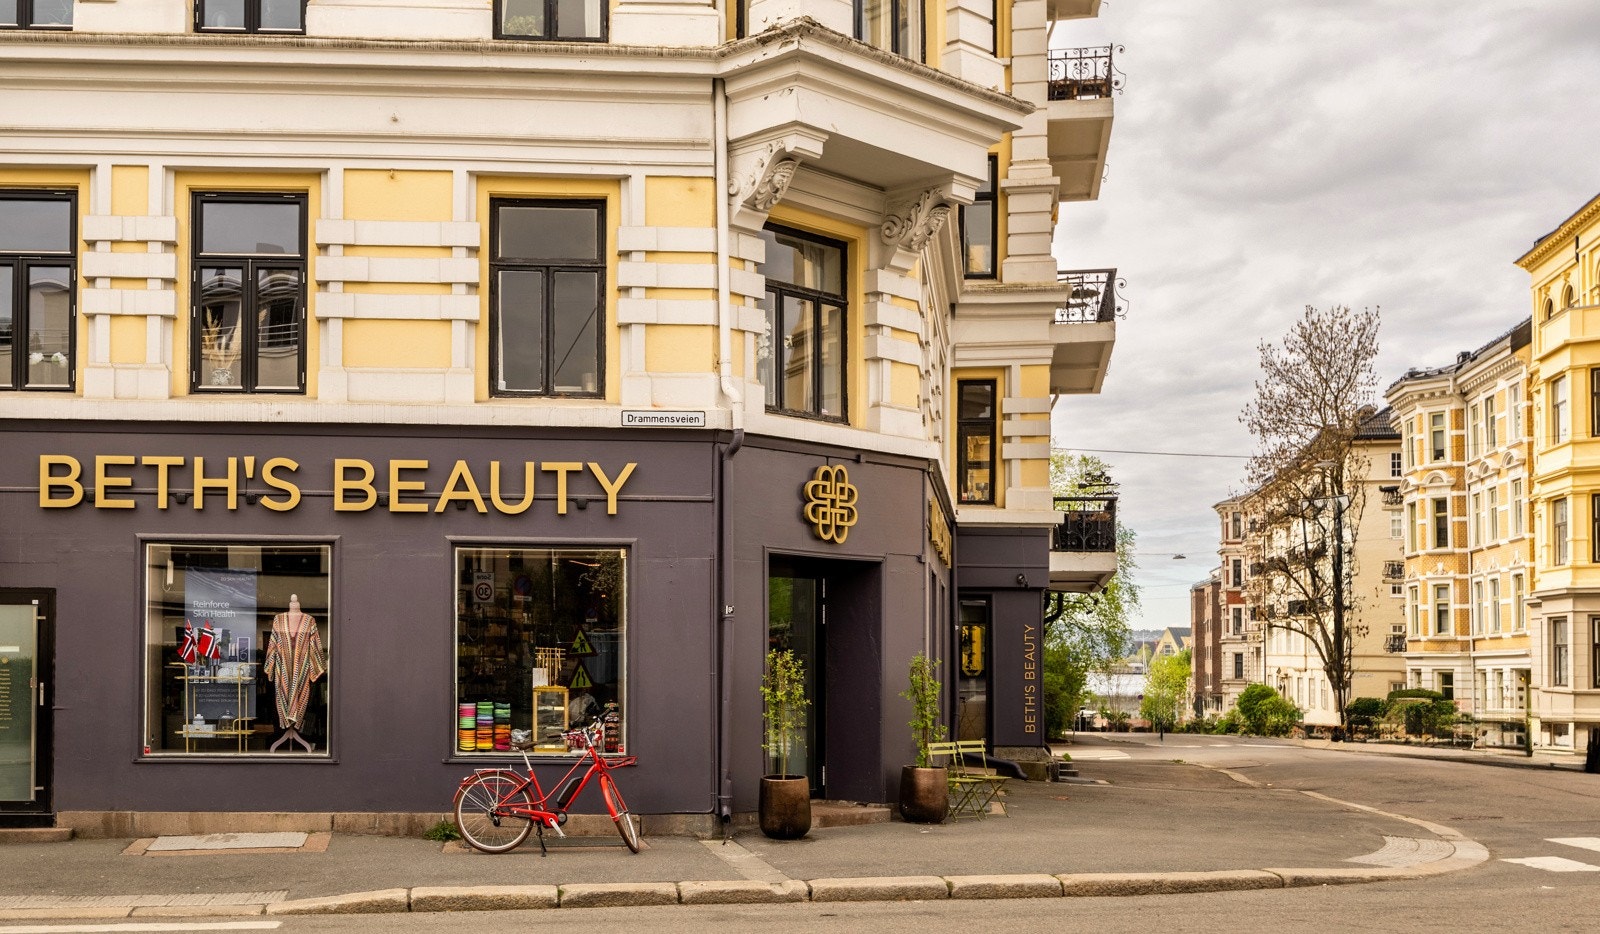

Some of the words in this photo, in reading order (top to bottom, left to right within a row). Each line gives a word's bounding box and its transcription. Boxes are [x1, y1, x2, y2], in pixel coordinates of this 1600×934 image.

[627, 414, 700, 424] Drammensveien
[39, 454, 301, 512] BETH'S
[333, 458, 638, 515] BEAUTY
[193, 600, 230, 608] Reinforce
[193, 609, 209, 618] Skin
[210, 610, 236, 618] Health
[1024, 624, 1035, 680] BEAUTY
[1024, 685, 1036, 733] BETH'S
